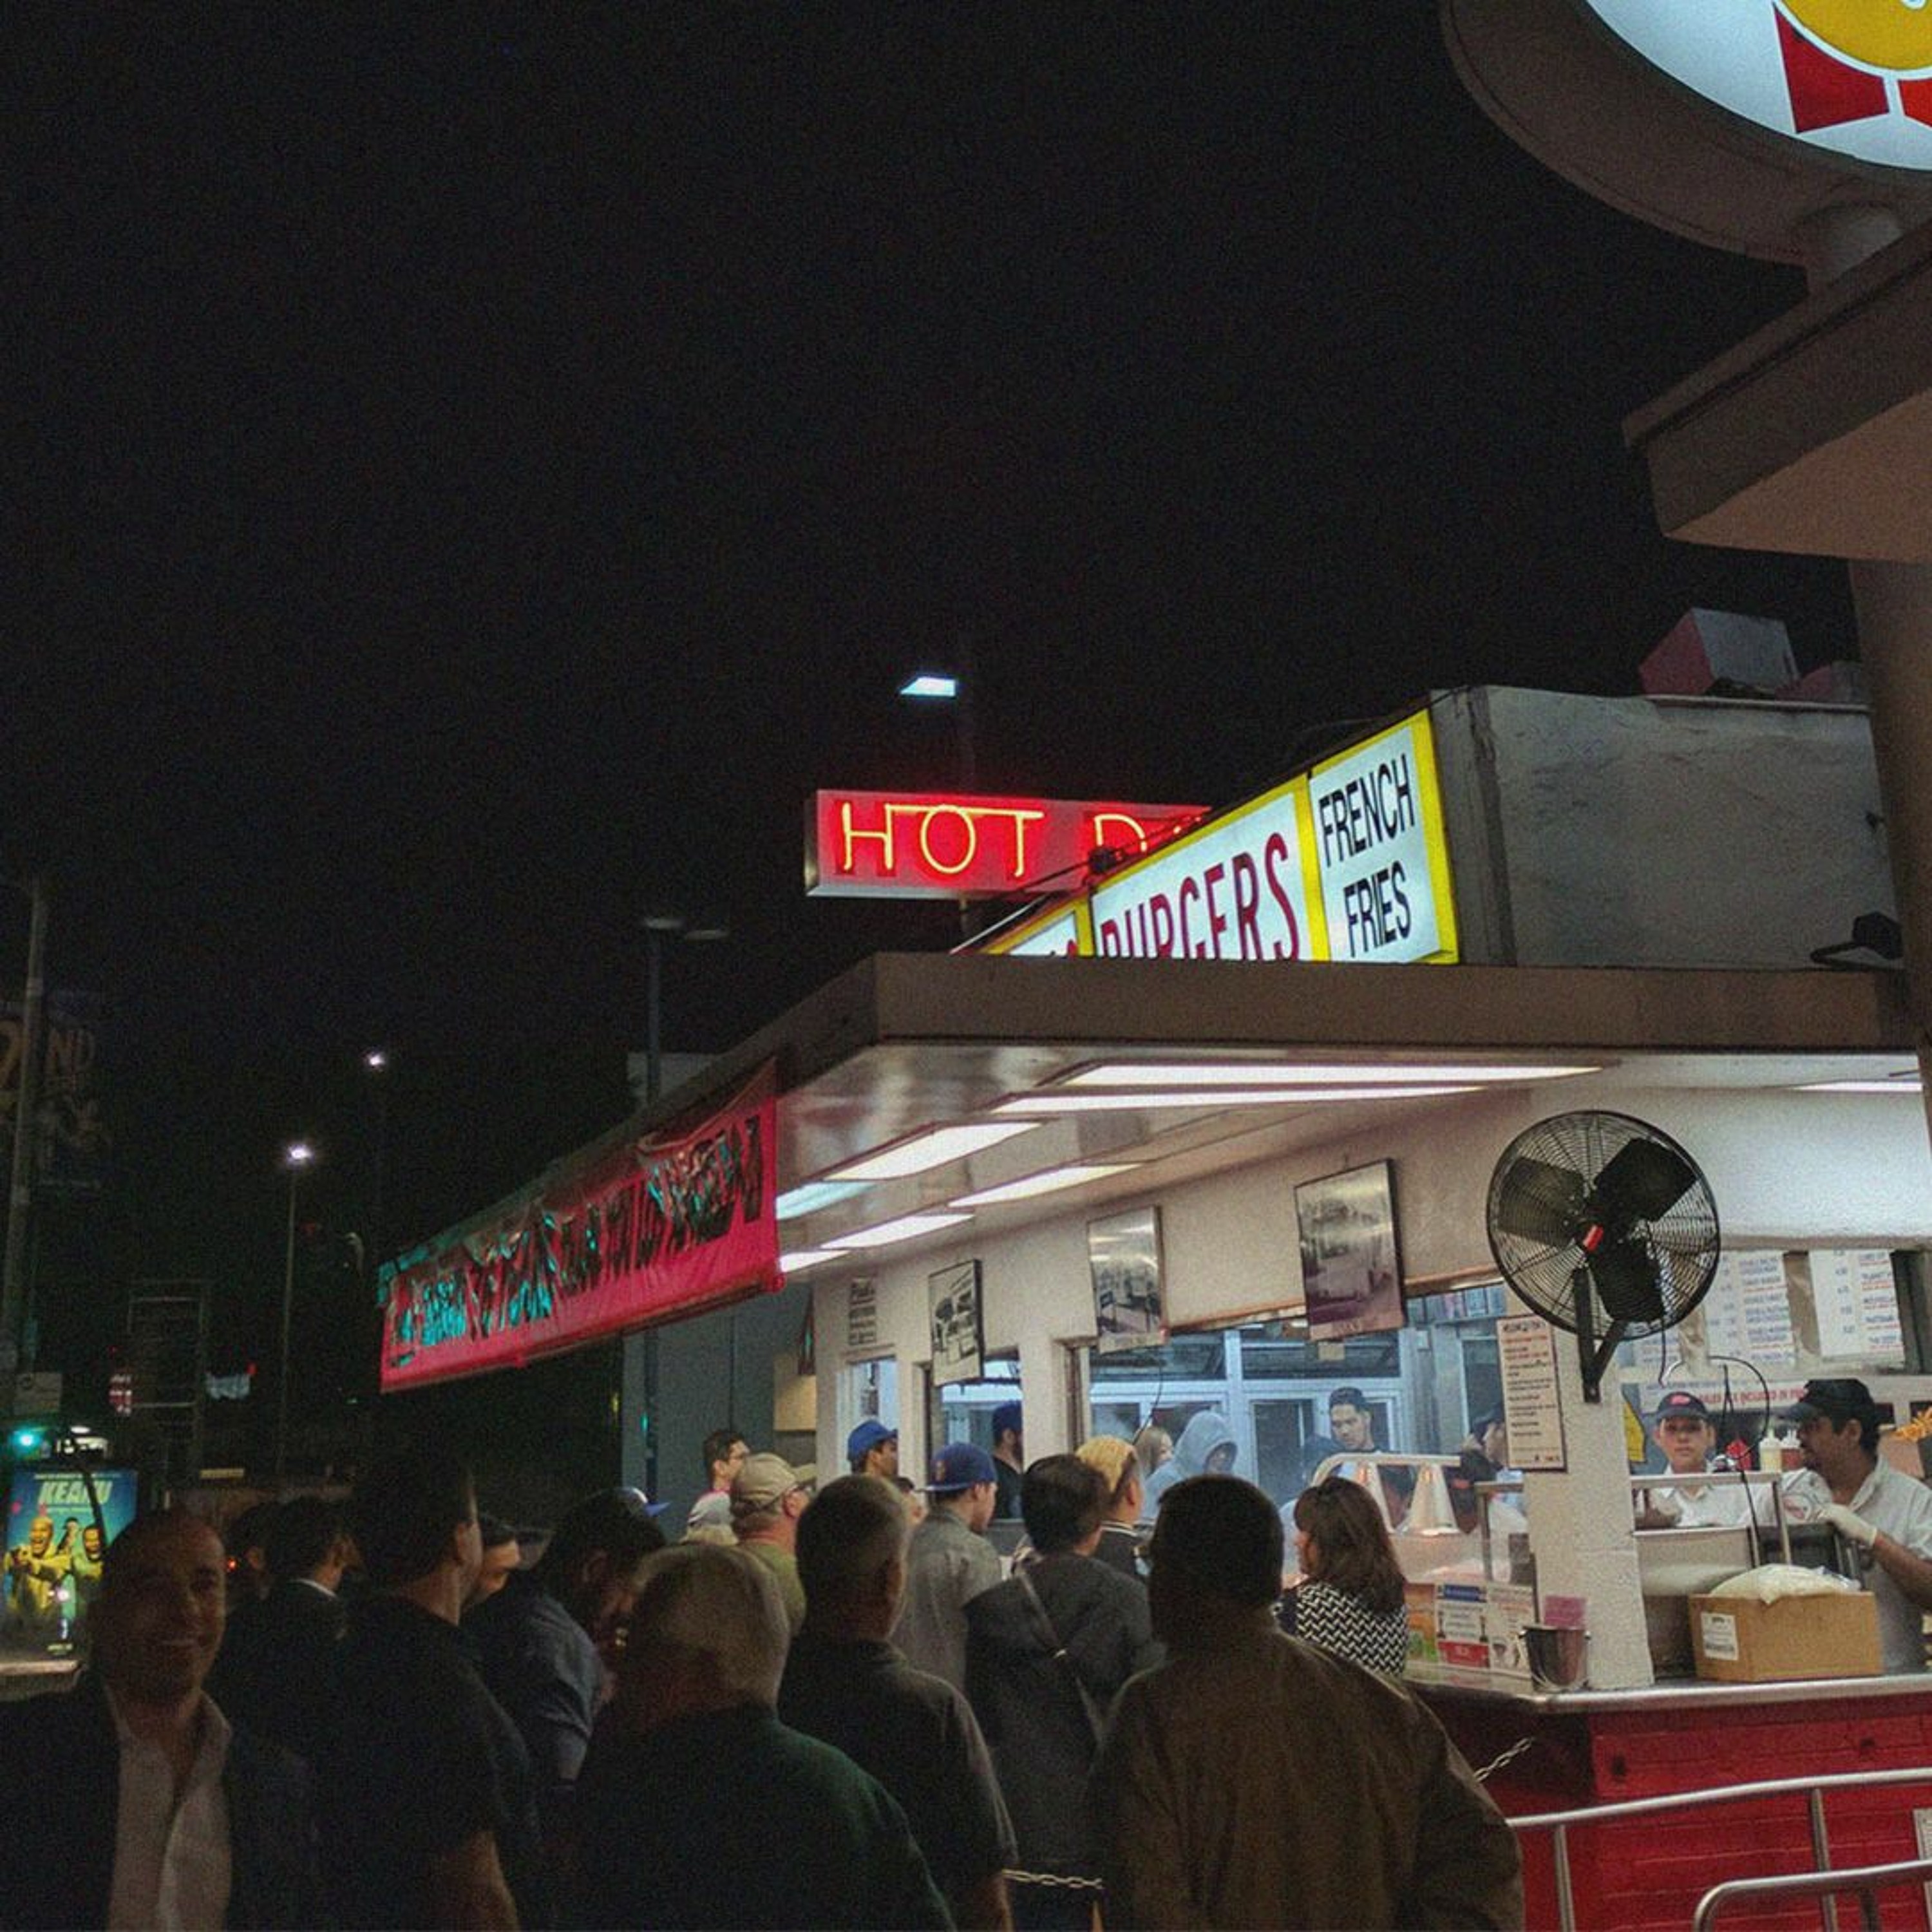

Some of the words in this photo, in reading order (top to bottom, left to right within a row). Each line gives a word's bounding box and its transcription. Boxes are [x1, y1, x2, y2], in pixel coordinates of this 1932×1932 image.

[842, 802, 1045, 878] HOT
[1319, 752, 1415, 868] FRENCH
[1343, 860, 1412, 958] FRIES
